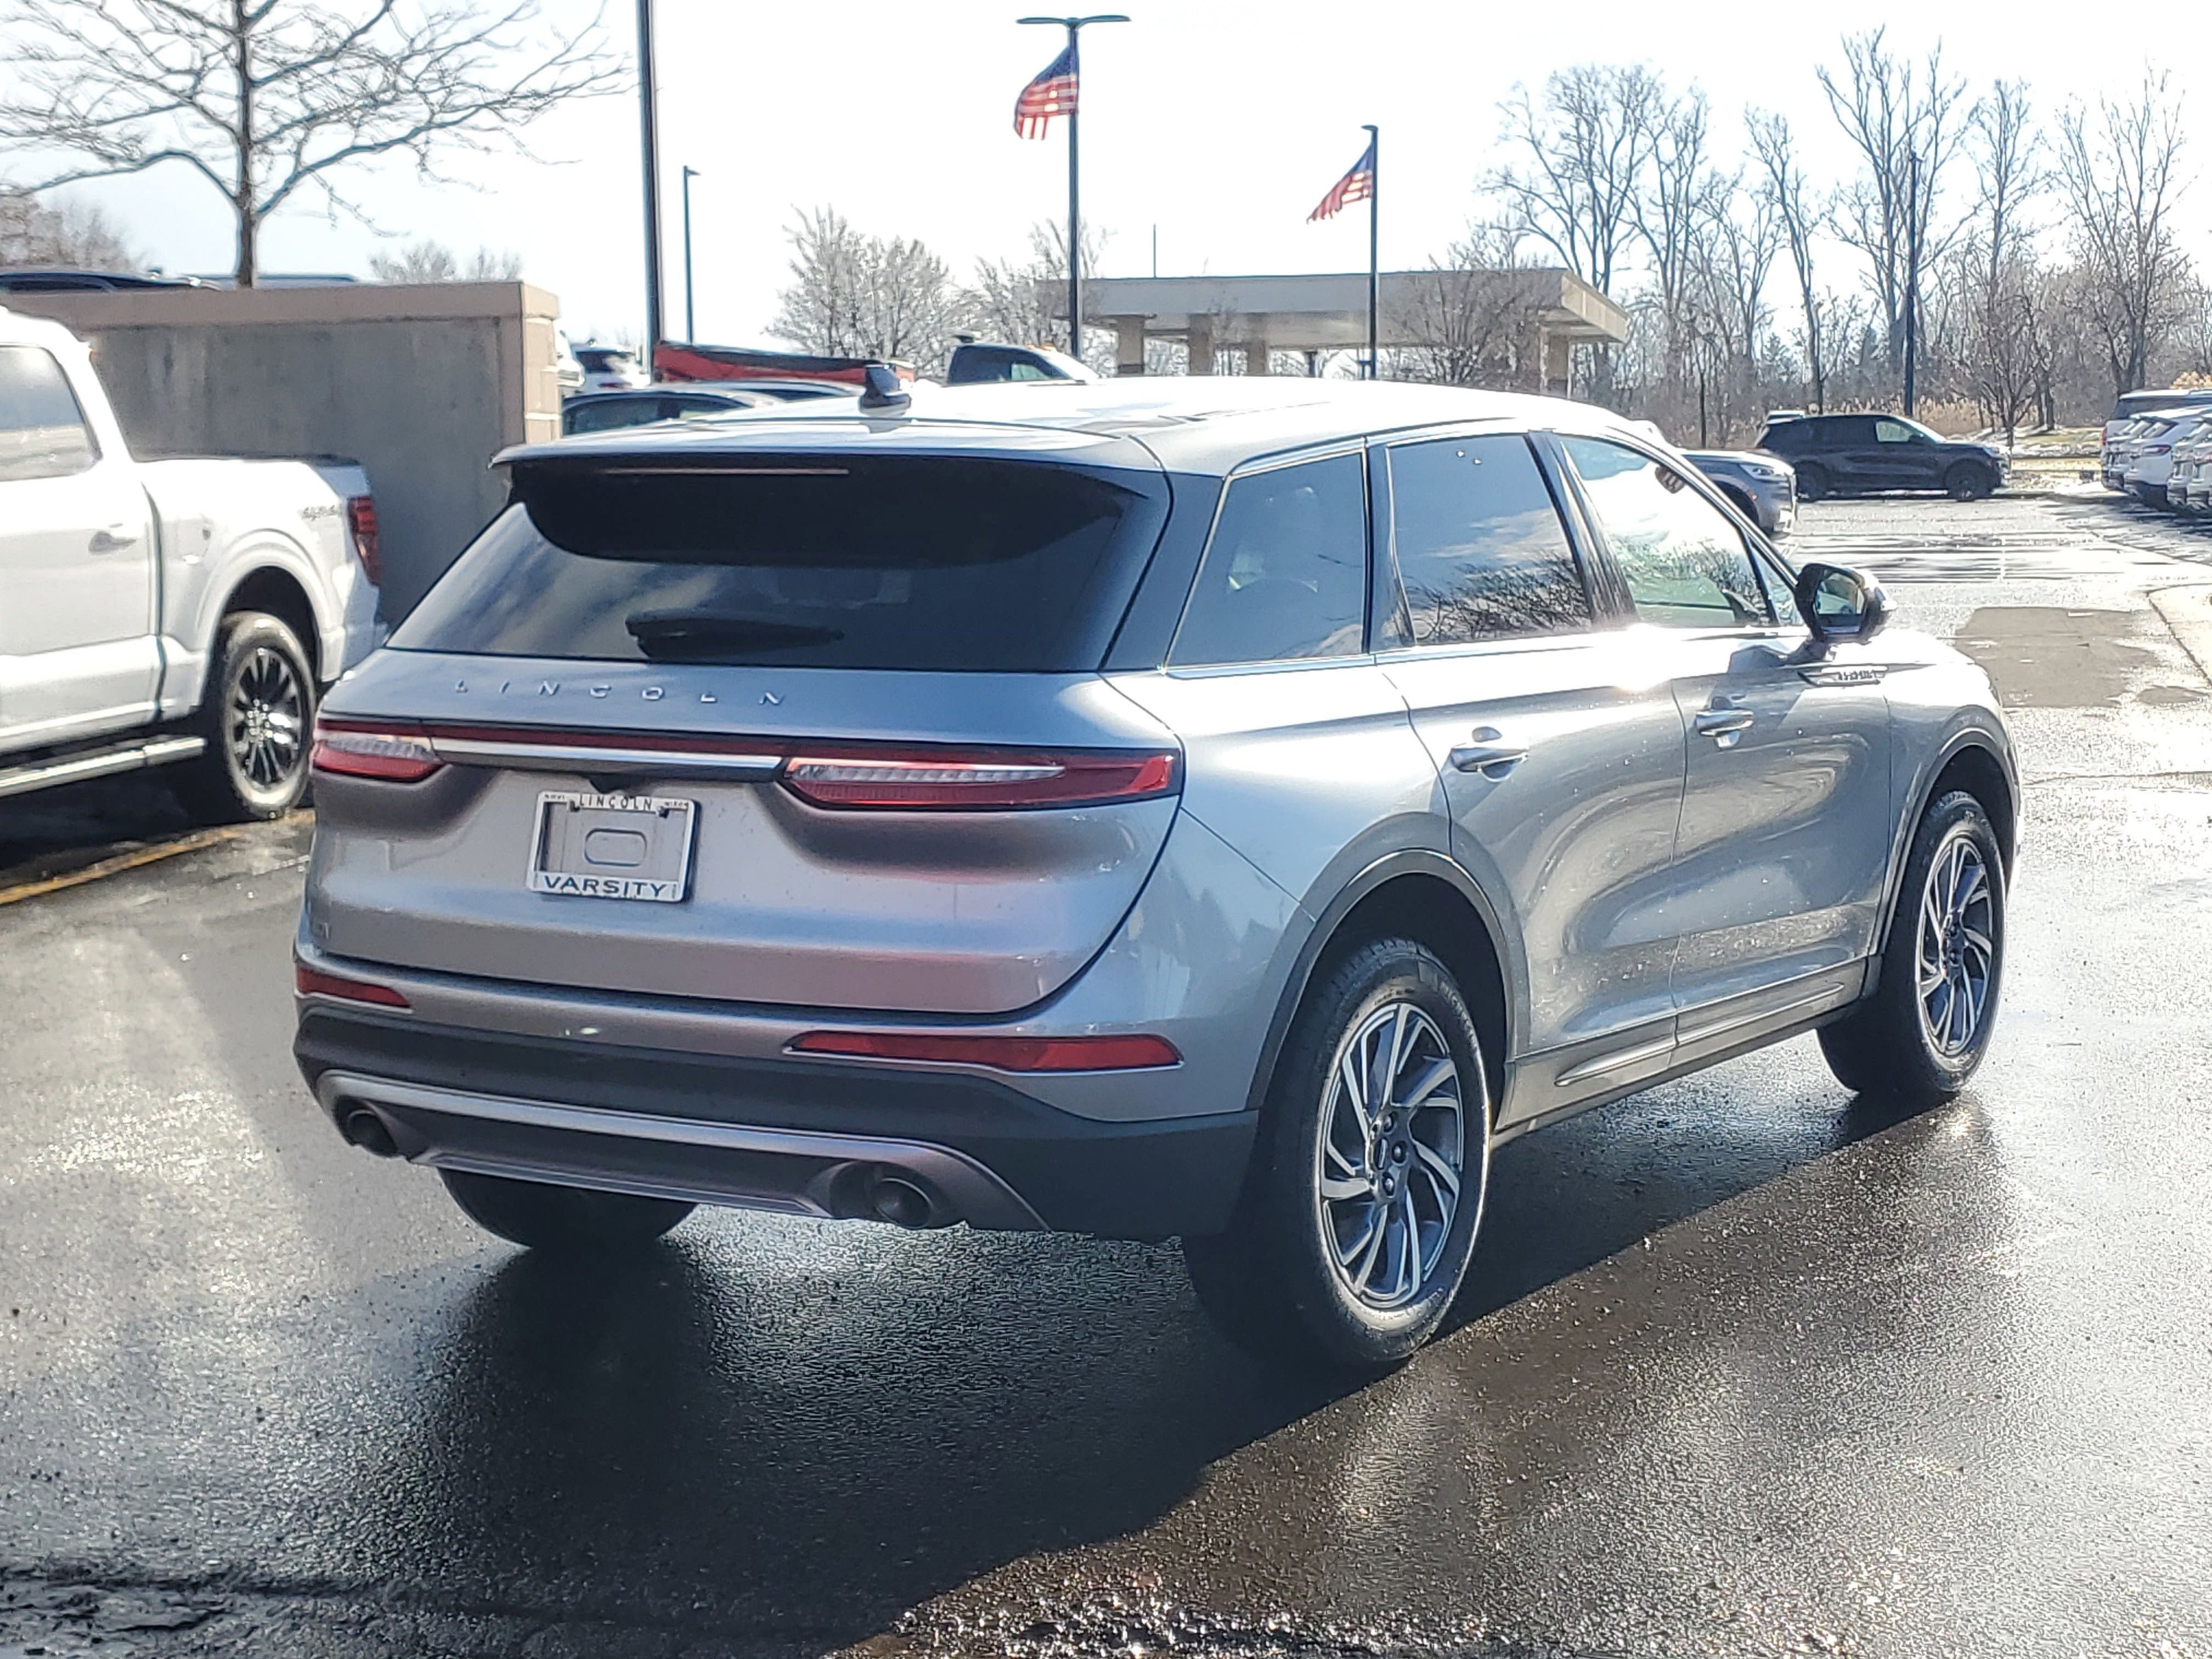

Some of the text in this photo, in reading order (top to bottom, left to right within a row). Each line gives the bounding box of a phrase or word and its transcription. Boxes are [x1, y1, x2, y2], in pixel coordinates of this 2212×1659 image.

[454, 680, 785, 707] LINCOLN
[579, 794, 652, 811] LINCOLN
[544, 876, 667, 898] VARSITY
